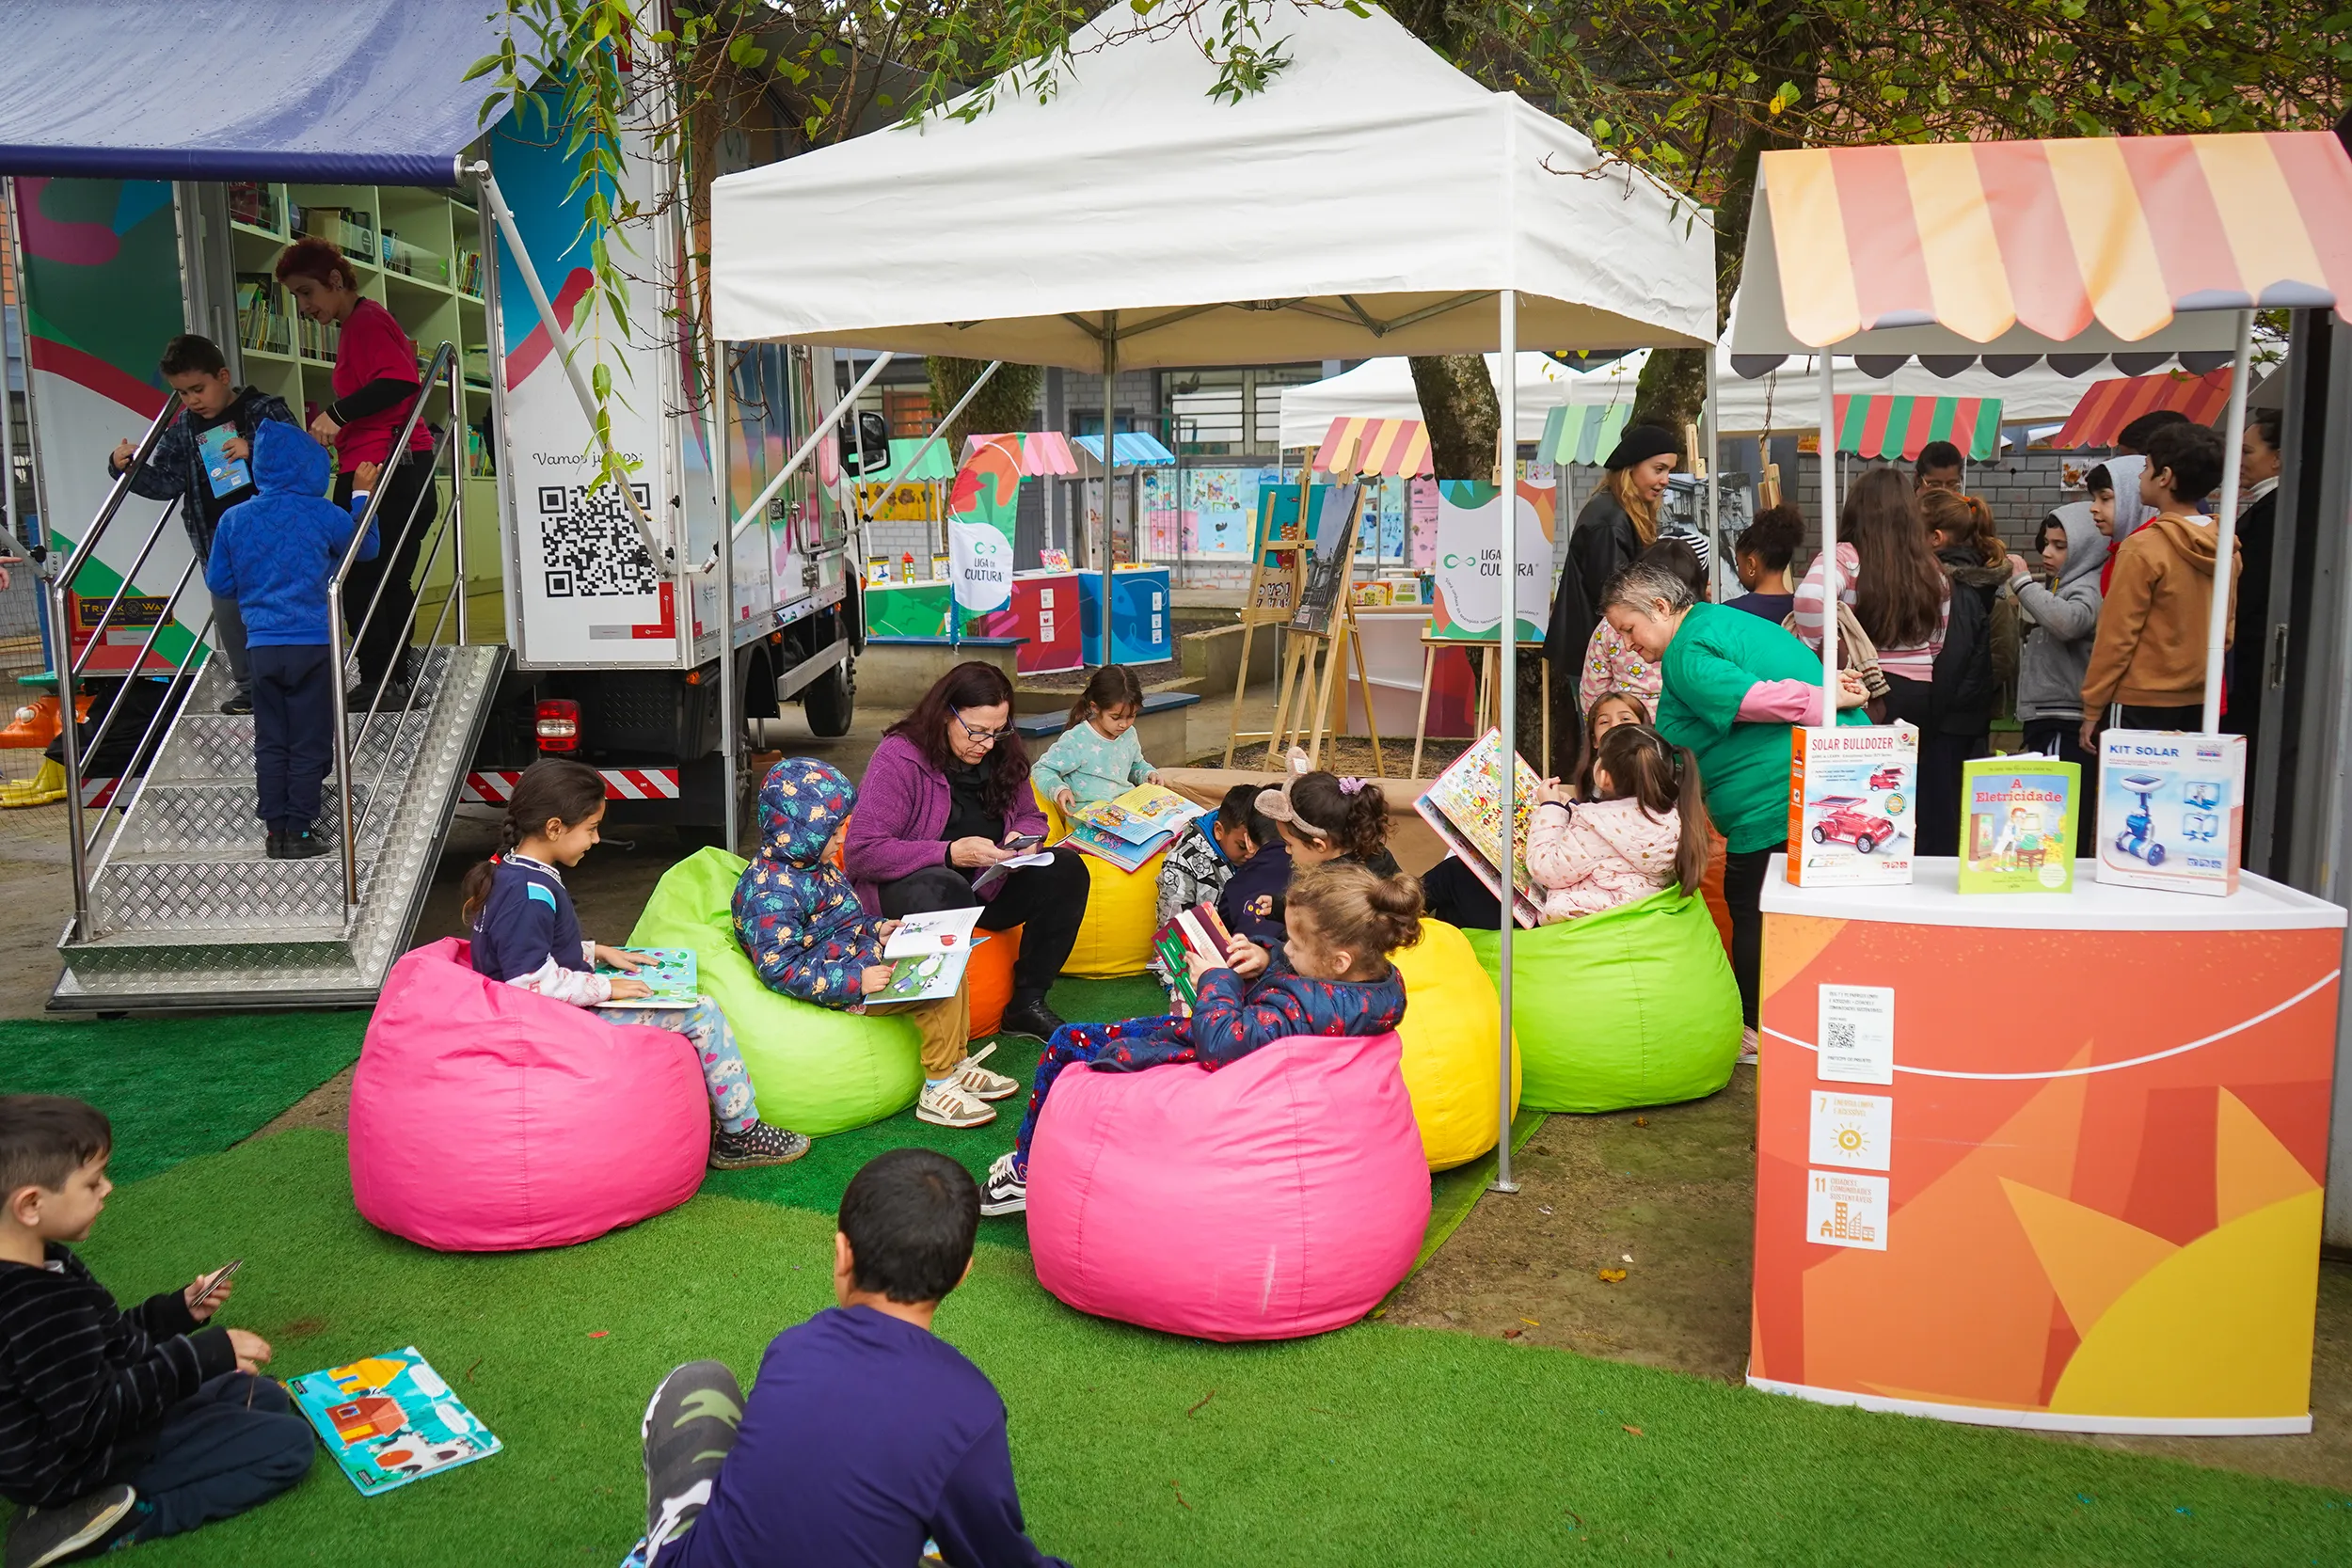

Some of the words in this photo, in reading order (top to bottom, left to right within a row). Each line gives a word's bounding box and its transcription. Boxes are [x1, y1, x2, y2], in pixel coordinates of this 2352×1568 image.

[532, 452, 587, 466] Vamos
[1481, 549, 1502, 561] LIGA
[974, 558, 989, 568] LIGA
[964, 568, 1003, 582] CULTURA
[1480, 562, 1534, 577] CULRA
[1812, 738, 1840, 751] SOLAR
[1844, 737, 1894, 750] BULLDOZER
[2109, 745, 2132, 754] KIT
[2136, 746, 2179, 757] SOLAR
[2011, 779, 2023, 788] A
[1976, 791, 2062, 802] Eletricidade
[1820, 1097, 1827, 1113] 7
[1815, 1178, 1826, 1193] 11
[1831, 1178, 1853, 1186] CIDADES
[1830, 1185, 1872, 1196] COMUNIDADES
[1830, 1194, 1873, 1204] SUSTENTÁVEIS
